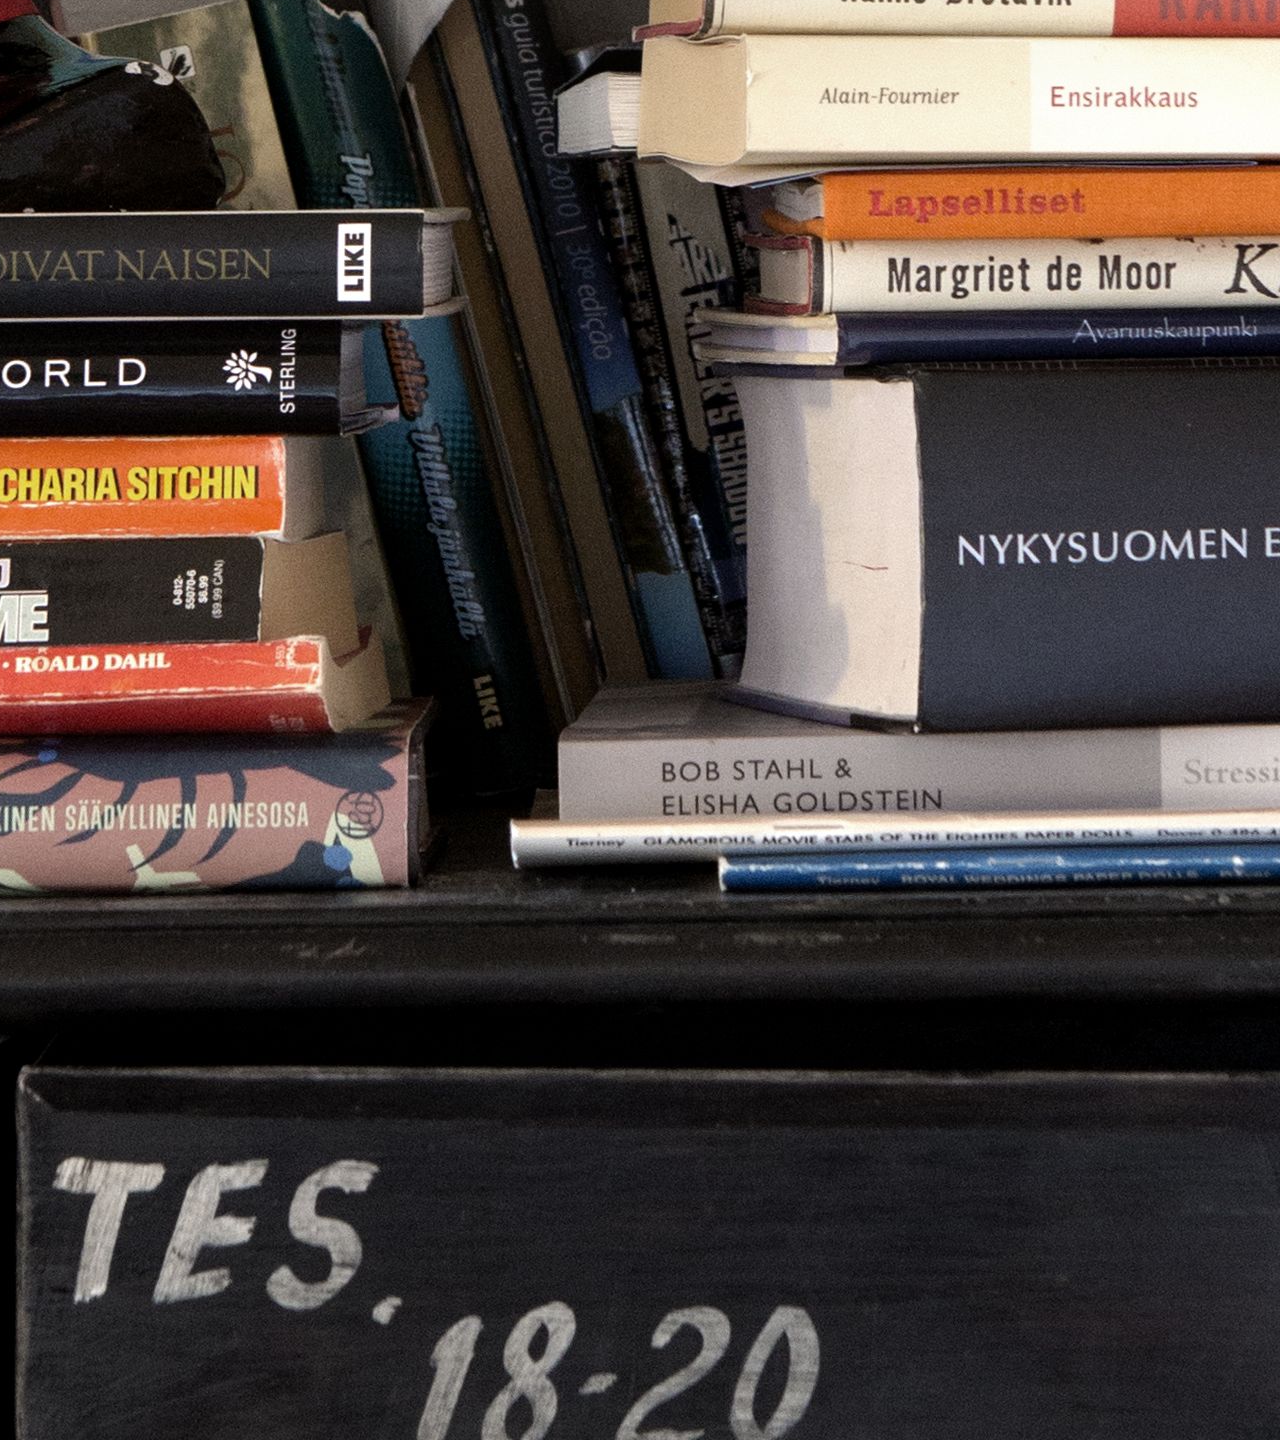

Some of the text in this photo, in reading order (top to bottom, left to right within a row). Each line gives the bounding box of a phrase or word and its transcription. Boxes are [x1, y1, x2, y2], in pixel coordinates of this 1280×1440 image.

[819, 84, 1200, 111] Alain-Fournier Ensirakkaus
[867, 186, 1087, 224] Lapselliset
[115, 246, 273, 282] NAISEN
[343, 230, 366, 294] LIKE
[886, 255, 1033, 300] Margriet
[1045, 255, 1083, 293] de
[1098, 254, 1178, 291] Moor
[1071, 315, 1259, 347] Avaruuskaupunki
[278, 327, 299, 414] STERLING
[126, 463, 258, 502] SITCHIN
[956, 526, 1250, 569] NYKYSUOMEN
[184, 568, 197, 612] 55070-6
[15, 654, 101, 675] ROALD
[103, 651, 171, 673] DAHL
[471, 672, 504, 730] LIKE
[661, 757, 853, 784] BOB STAHL &
[64, 799, 198, 833] SÄÄDYLLINEN
[206, 799, 310, 829] AINESOSA
[661, 788, 944, 818] ELISHA GOLDSTEIN
[51, 1156, 403, 1325] TES.
